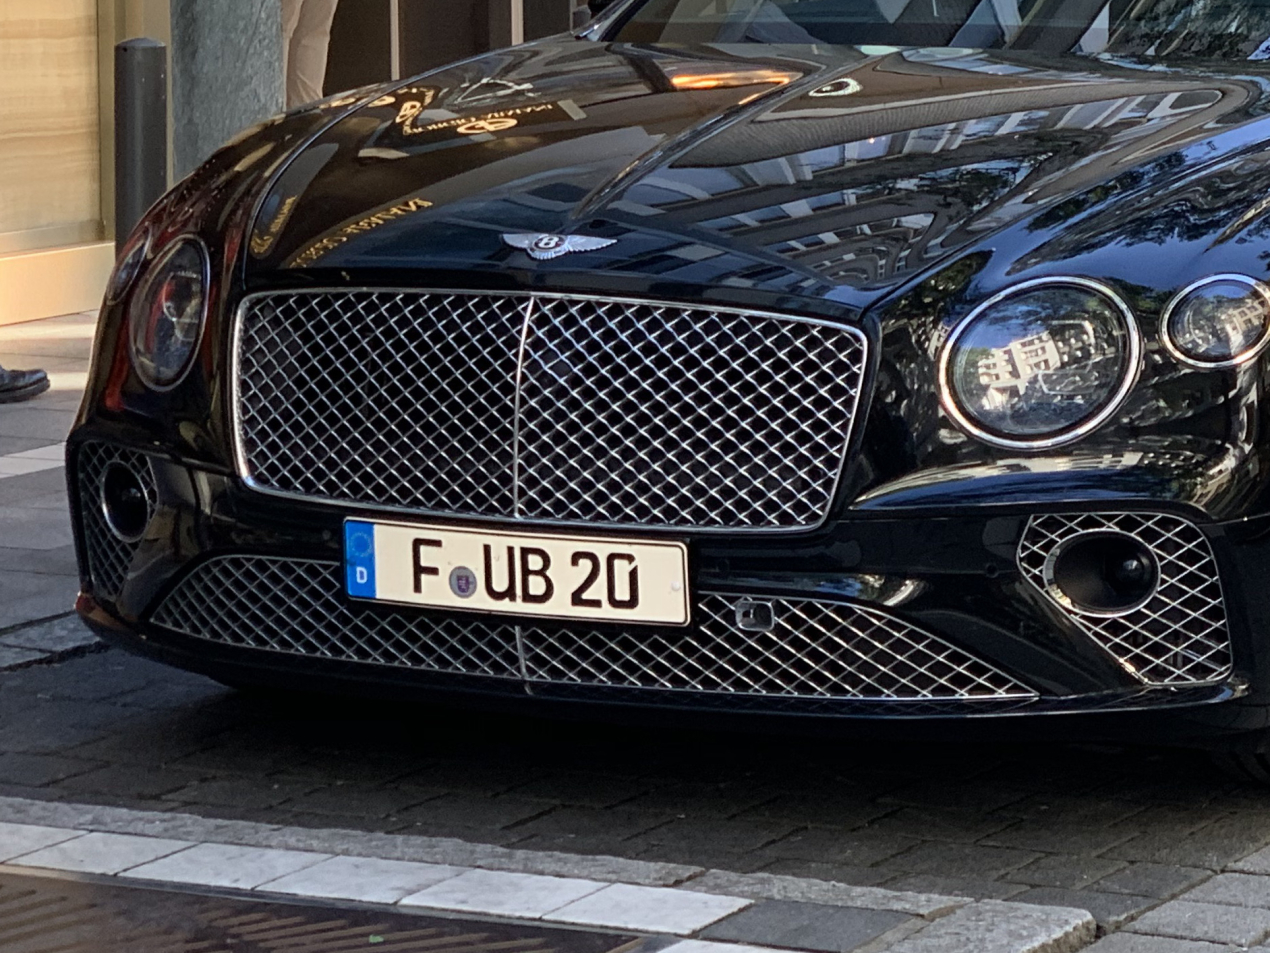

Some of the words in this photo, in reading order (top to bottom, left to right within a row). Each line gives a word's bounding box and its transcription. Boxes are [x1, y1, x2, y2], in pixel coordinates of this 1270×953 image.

[356, 566, 368, 584] D
[412, 538, 442, 594] F
[483, 544, 554, 604] UB
[570, 551, 639, 610] 20
